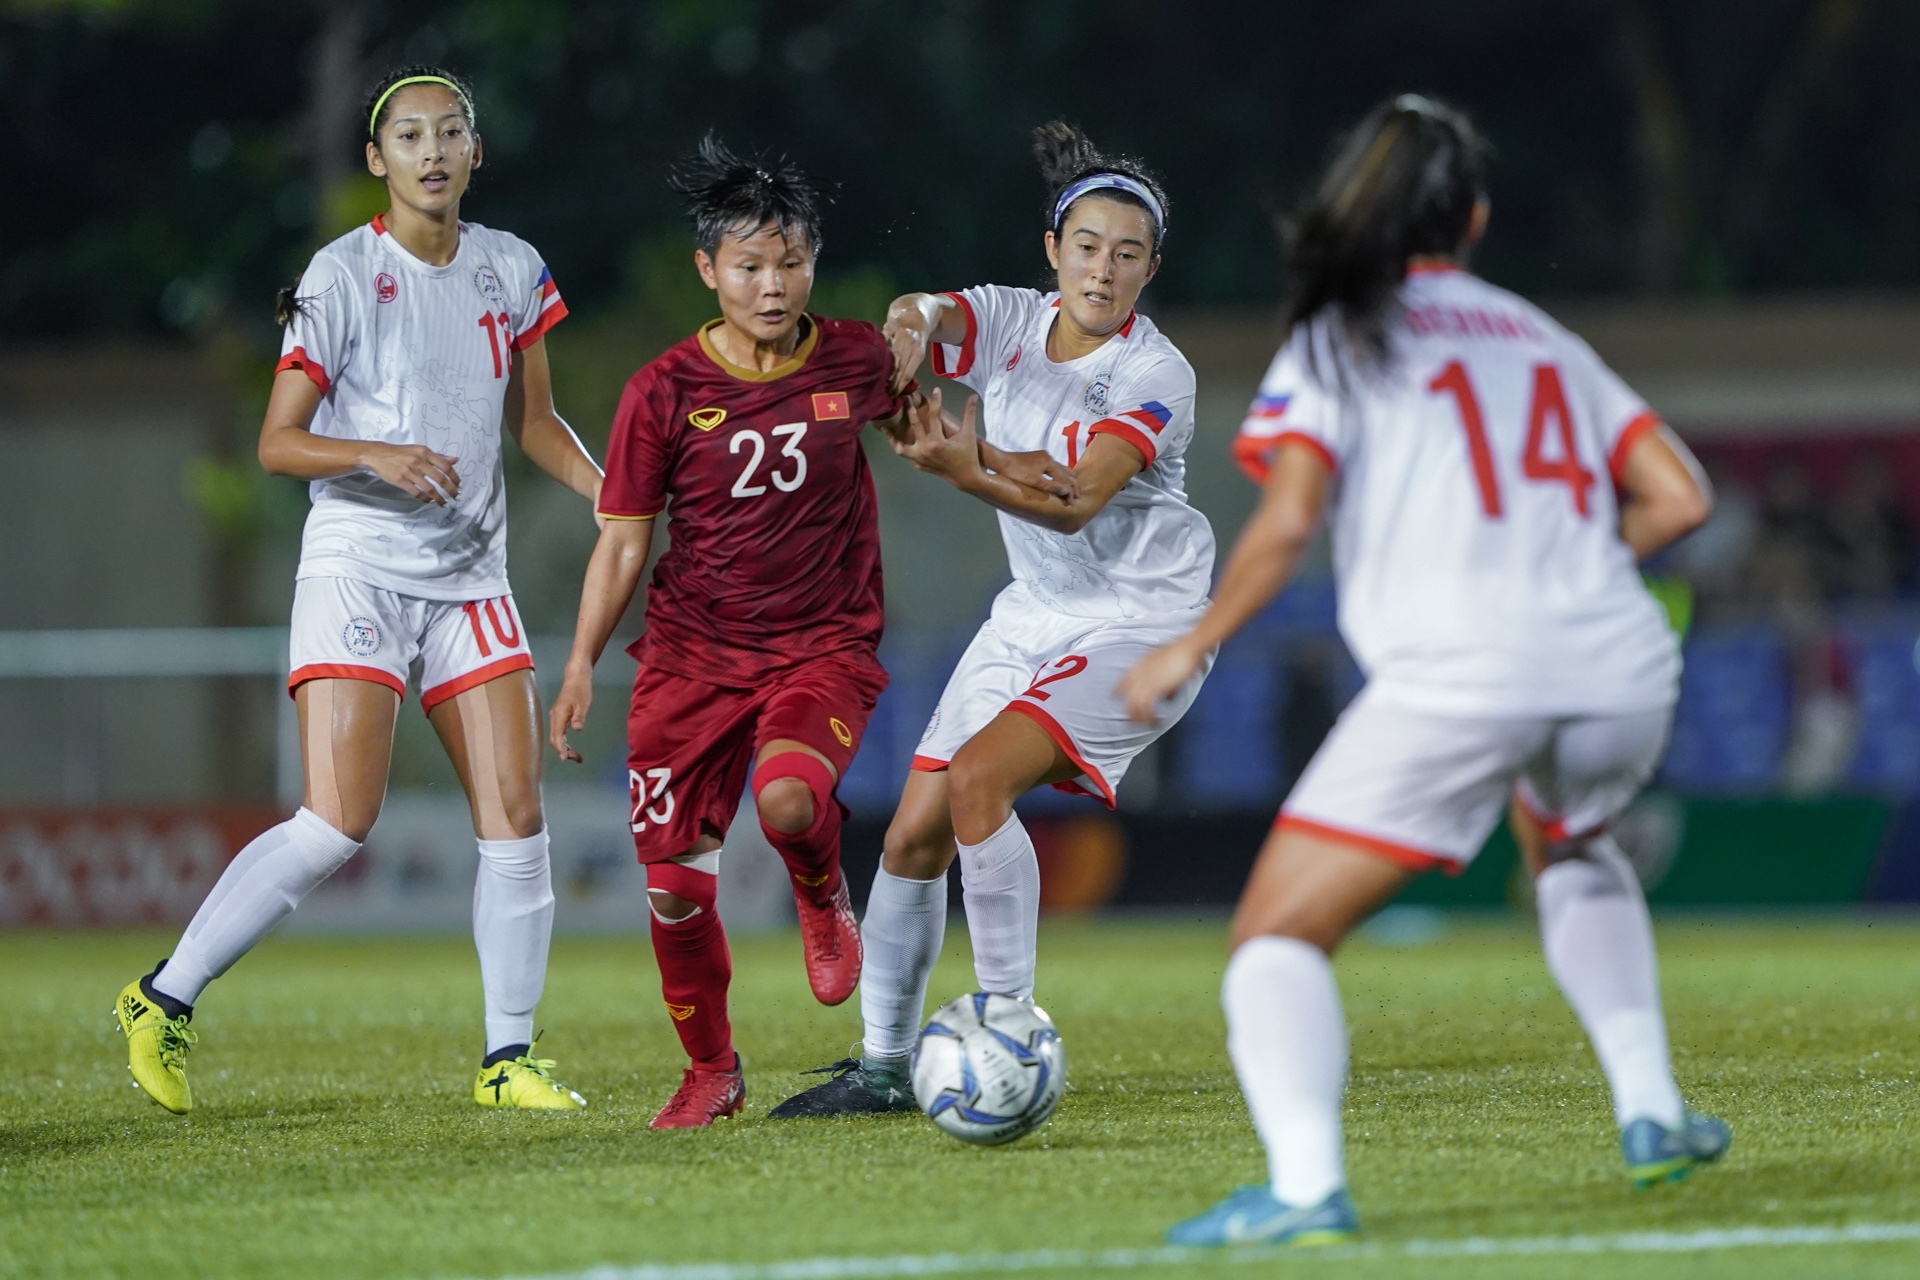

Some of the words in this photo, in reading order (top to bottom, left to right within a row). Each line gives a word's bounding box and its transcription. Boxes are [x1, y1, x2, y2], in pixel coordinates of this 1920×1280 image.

[730, 422, 807, 498] 23
[1430, 360, 1595, 517] 14
[353, 638, 375, 648] PFF
[463, 596, 519, 658] 10
[631, 768, 675, 833] 23
[123, 995, 132, 1033] adidas
